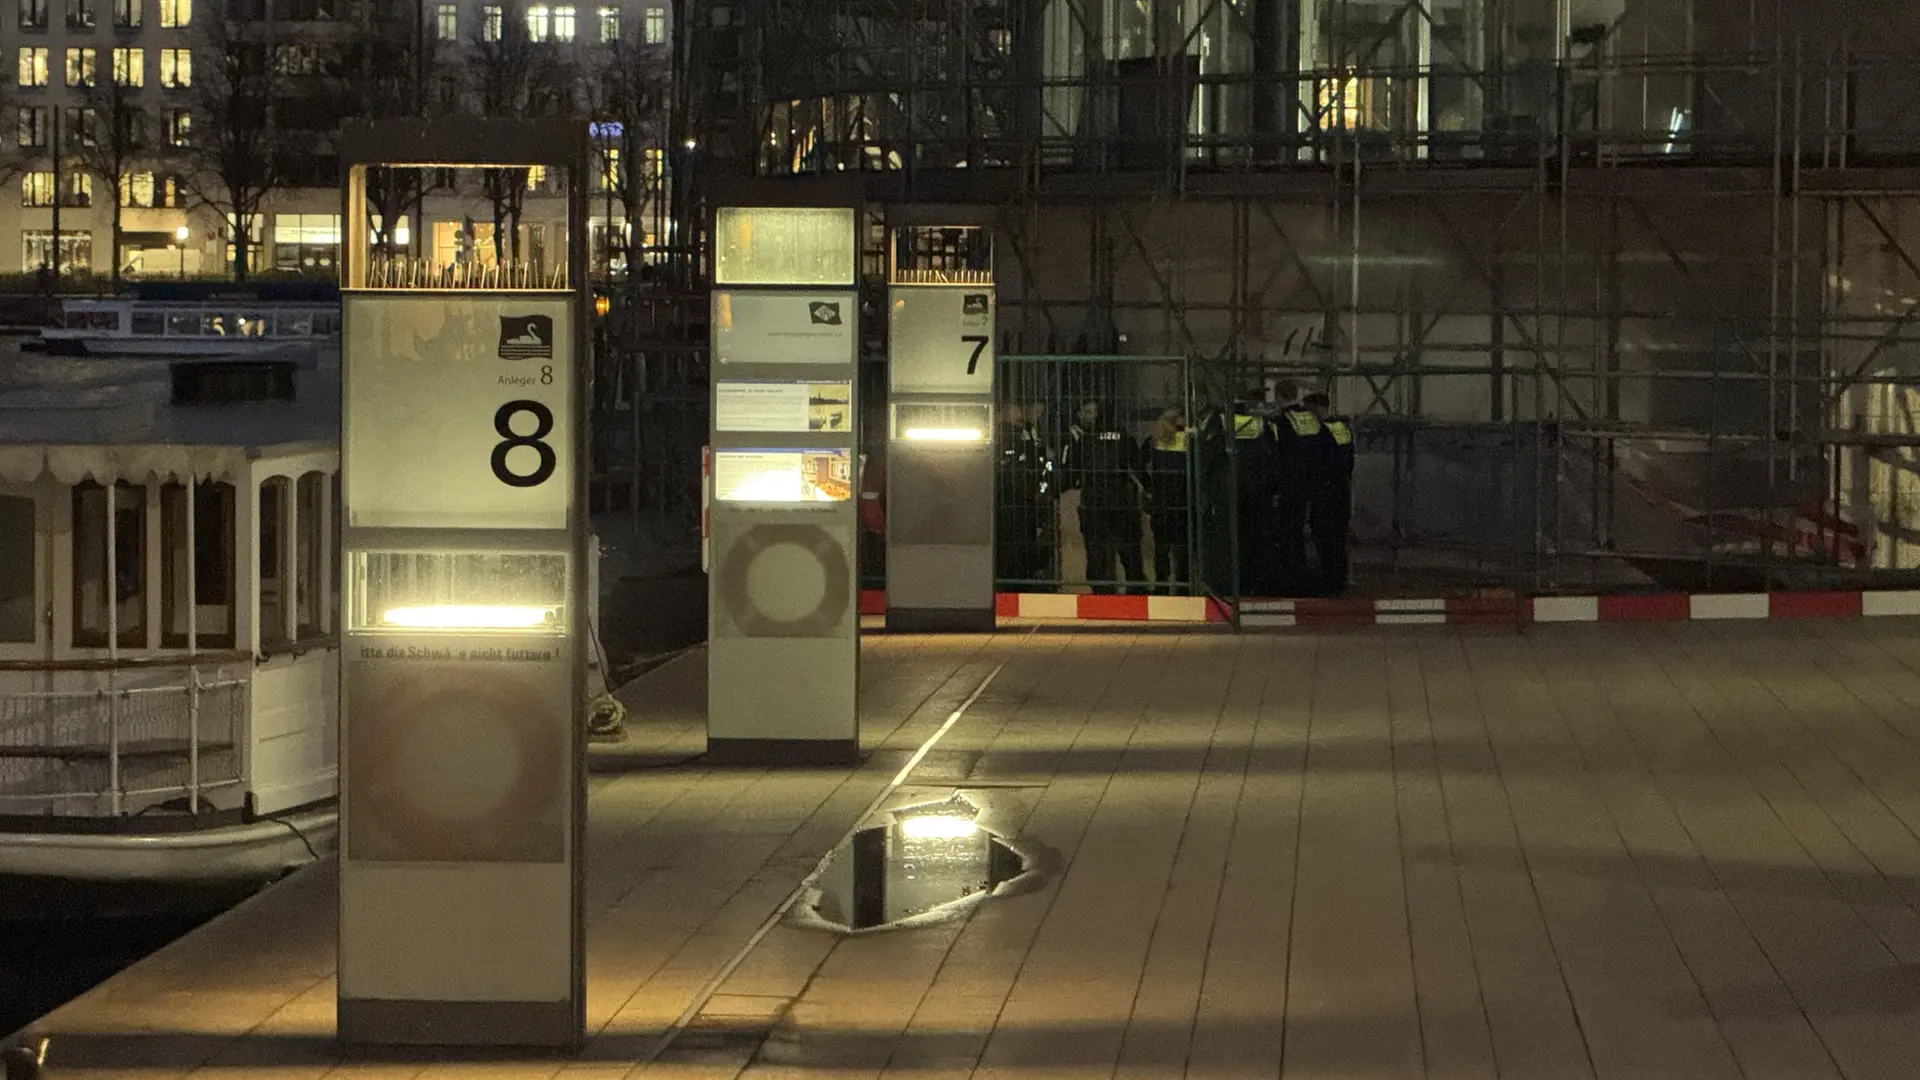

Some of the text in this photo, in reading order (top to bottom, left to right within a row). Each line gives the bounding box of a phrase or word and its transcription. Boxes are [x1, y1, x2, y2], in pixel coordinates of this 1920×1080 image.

[961, 335, 989, 375] 7
[498, 365, 553, 387] Anleger 8
[491, 399, 557, 488] 8
